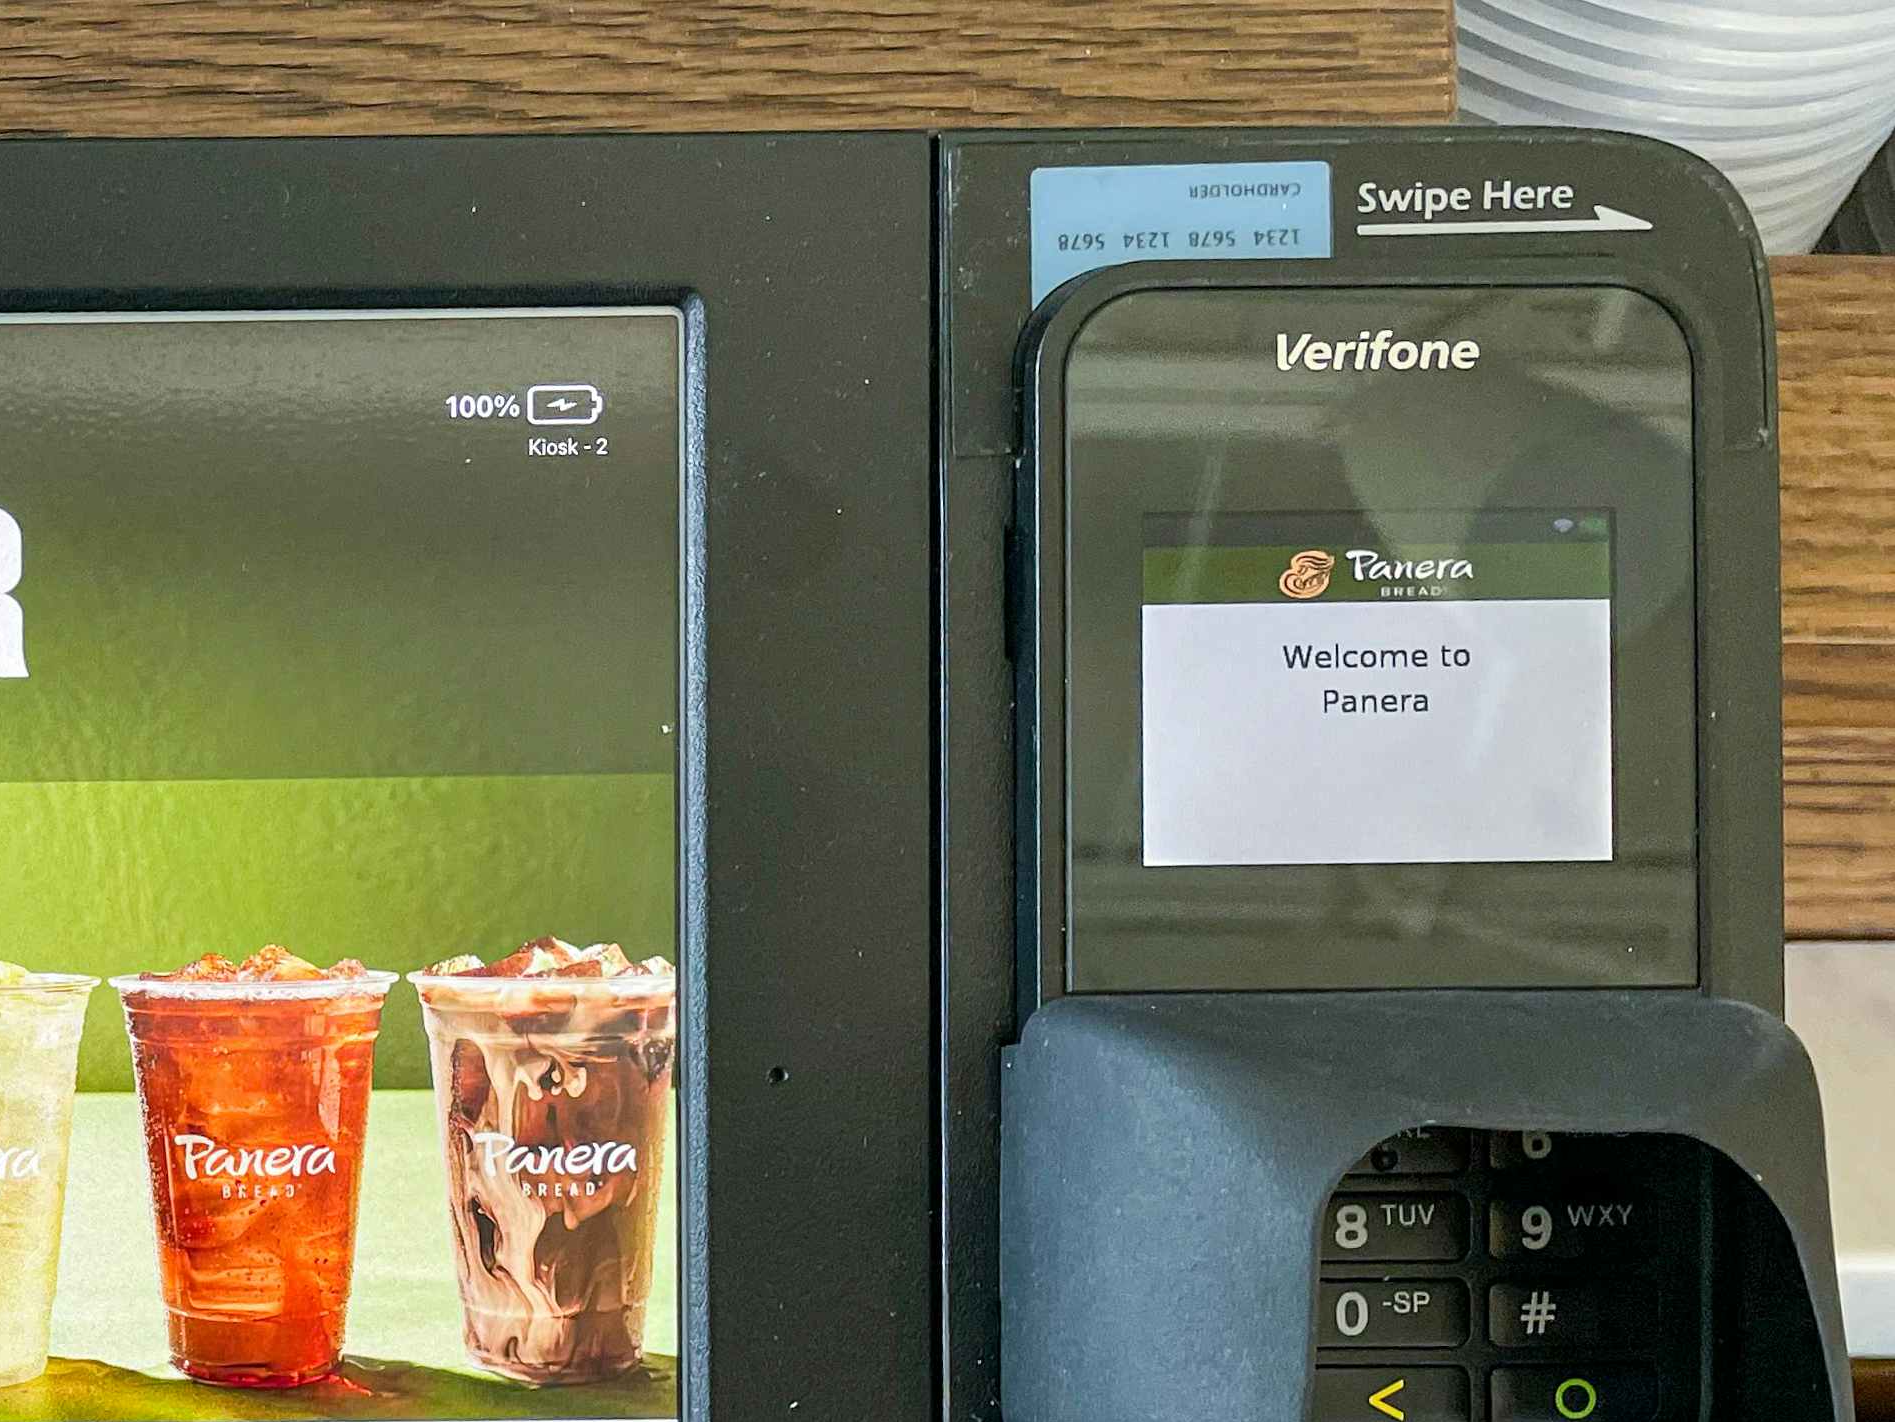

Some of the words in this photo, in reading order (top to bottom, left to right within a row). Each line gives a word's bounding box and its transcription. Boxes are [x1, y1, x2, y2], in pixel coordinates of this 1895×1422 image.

[1188, 182, 1302, 199] CARDHOLDER
[1357, 181, 1472, 221] Swipe
[1483, 181, 1574, 210] Here
[1058, 233, 1105, 250] 5678
[1123, 231, 1170, 249] 1234
[1188, 230, 1236, 246] 5678
[1253, 228, 1301, 245] 1234
[1275, 330, 1480, 372] Verifone
[445, 394, 520, 418] 100%
[528, 438, 579, 456] Kiosk
[596, 438, 608, 455] 2
[1345, 549, 1475, 582] Panera
[1380, 586, 1442, 597] BREAD
[1282, 643, 1428, 670] Welcome
[1441, 644, 1471, 669] to
[1323, 690, 1430, 715] Panera
[174, 1134, 336, 1180] Panera
[473, 1131, 637, 1177] Panera
[1335, 1204, 1368, 1249] 8
[1380, 1203, 1435, 1226] TUV
[1521, 1205, 1553, 1250] 9
[1567, 1203, 1633, 1227] WXY
[1336, 1291, 1368, 1337] 0
[1520, 1291, 1556, 1334] #
